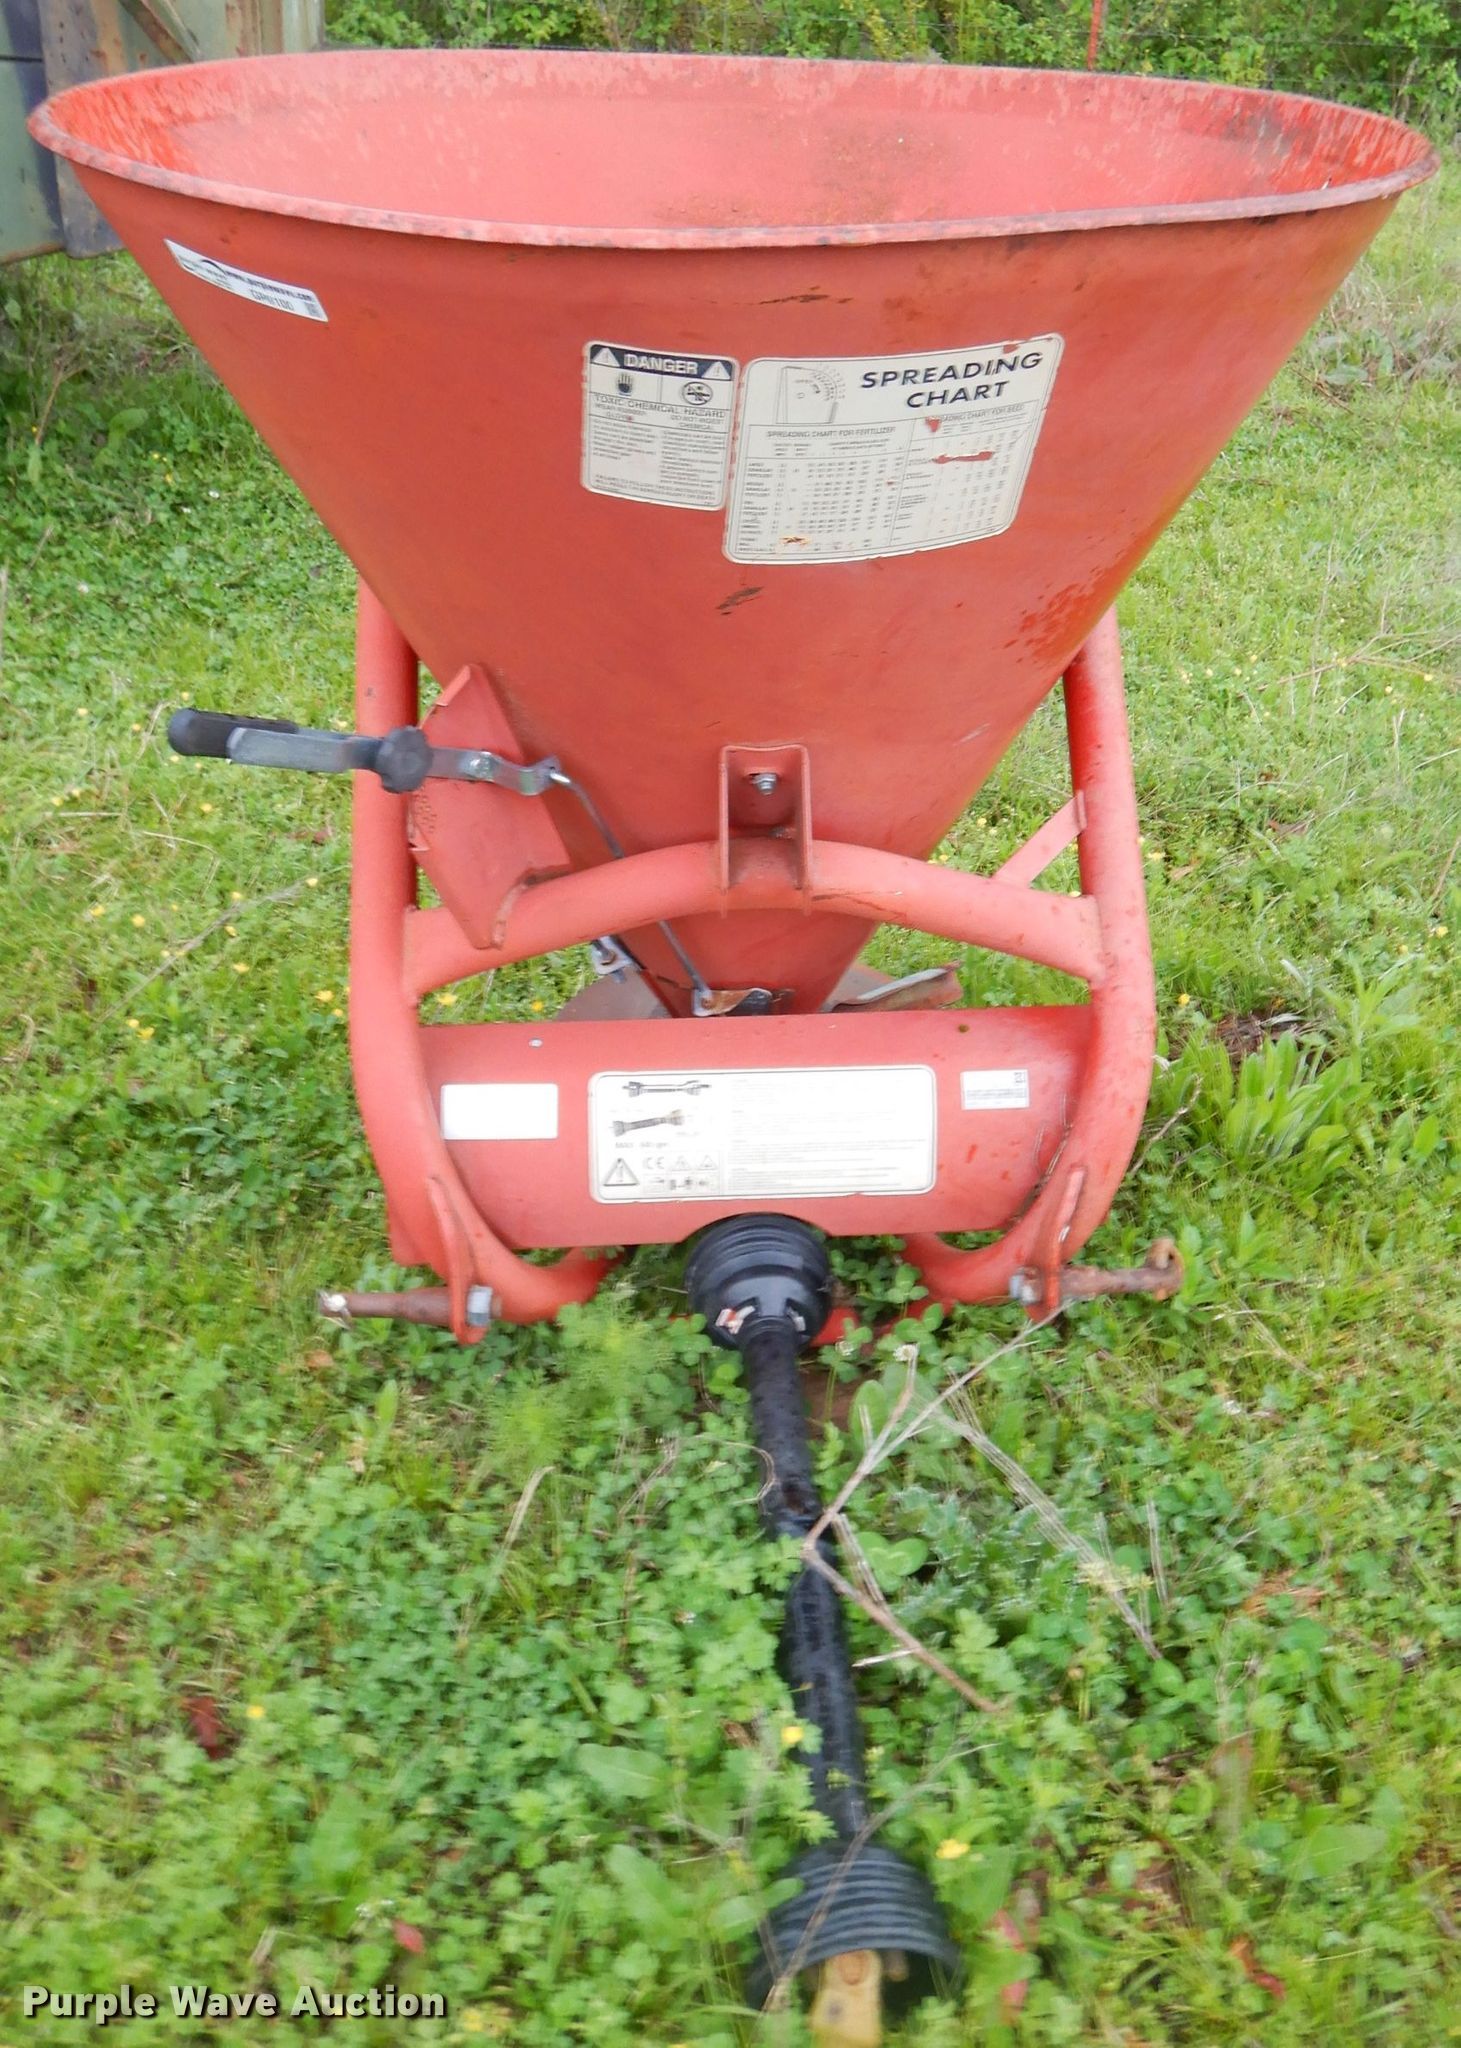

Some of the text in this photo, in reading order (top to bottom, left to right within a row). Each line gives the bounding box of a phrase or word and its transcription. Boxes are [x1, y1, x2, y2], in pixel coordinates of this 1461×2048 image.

[624, 354, 698, 375] DANGER
[861, 352, 1043, 388] SPREADING
[906, 381, 1010, 408] CHART
[596, 396, 624, 406] TOXIC
[628, 401, 680, 414] CHEMICAL
[684, 408, 725, 418] HAZARD
[767, 430, 810, 438] SPREADING
